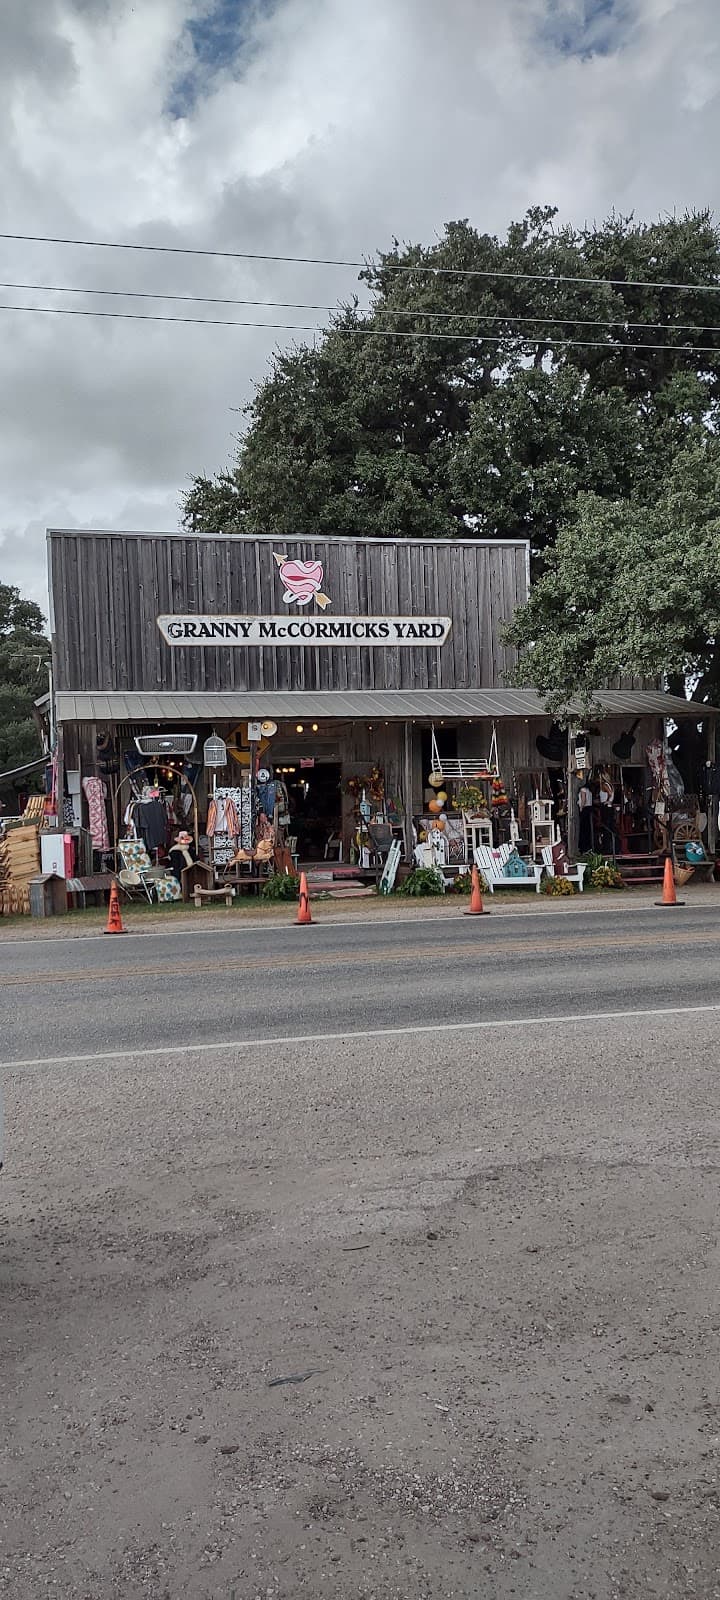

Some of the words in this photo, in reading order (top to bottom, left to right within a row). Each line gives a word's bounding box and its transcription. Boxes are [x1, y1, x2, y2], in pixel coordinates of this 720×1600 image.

[168, 622, 252, 638] GRANNY
[258, 622, 390, 638] McCORMICKS
[393, 623, 445, 638] YARD
